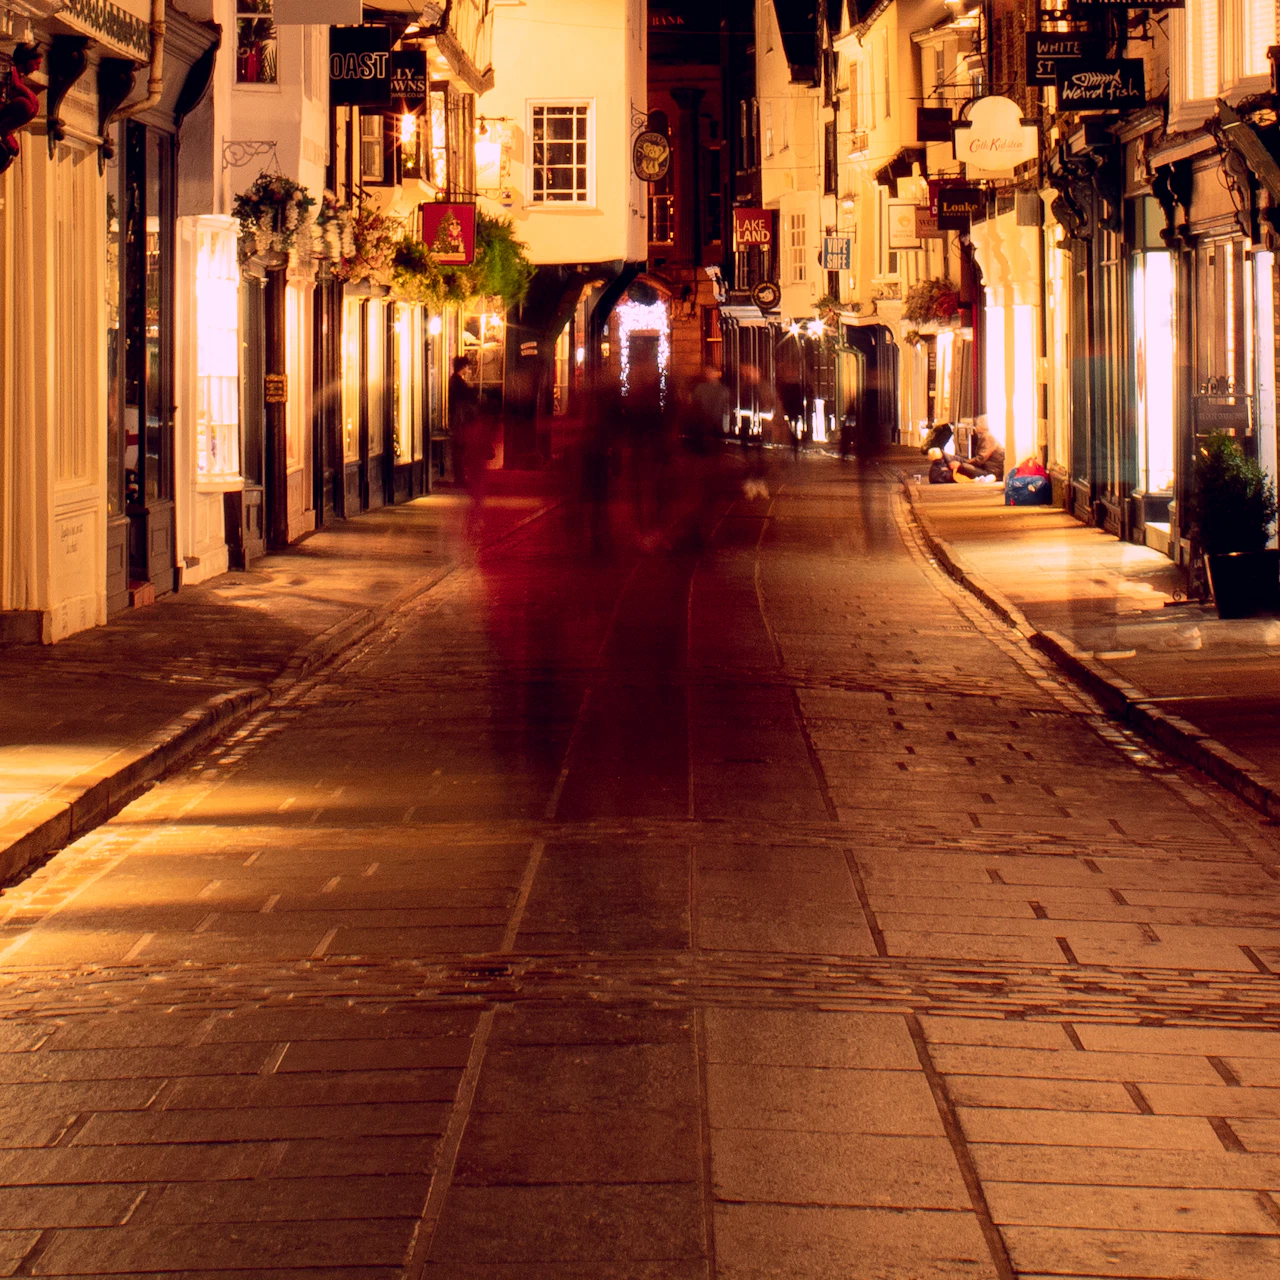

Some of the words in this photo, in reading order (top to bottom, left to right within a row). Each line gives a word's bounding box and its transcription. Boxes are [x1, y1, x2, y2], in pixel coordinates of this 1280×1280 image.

[652, 15, 686, 26] BANK
[1036, 40, 1081, 54] WHITE
[1036, 60, 1055, 72] ST
[1061, 81, 1104, 100] Weird
[1106, 81, 1140, 101] fish
[942, 201, 979, 212] Loake
[736, 219, 766, 232] LAKE
[736, 230, 771, 242] LAND
[827, 238, 848, 254] VAPE
[827, 253, 848, 269] SAFE
